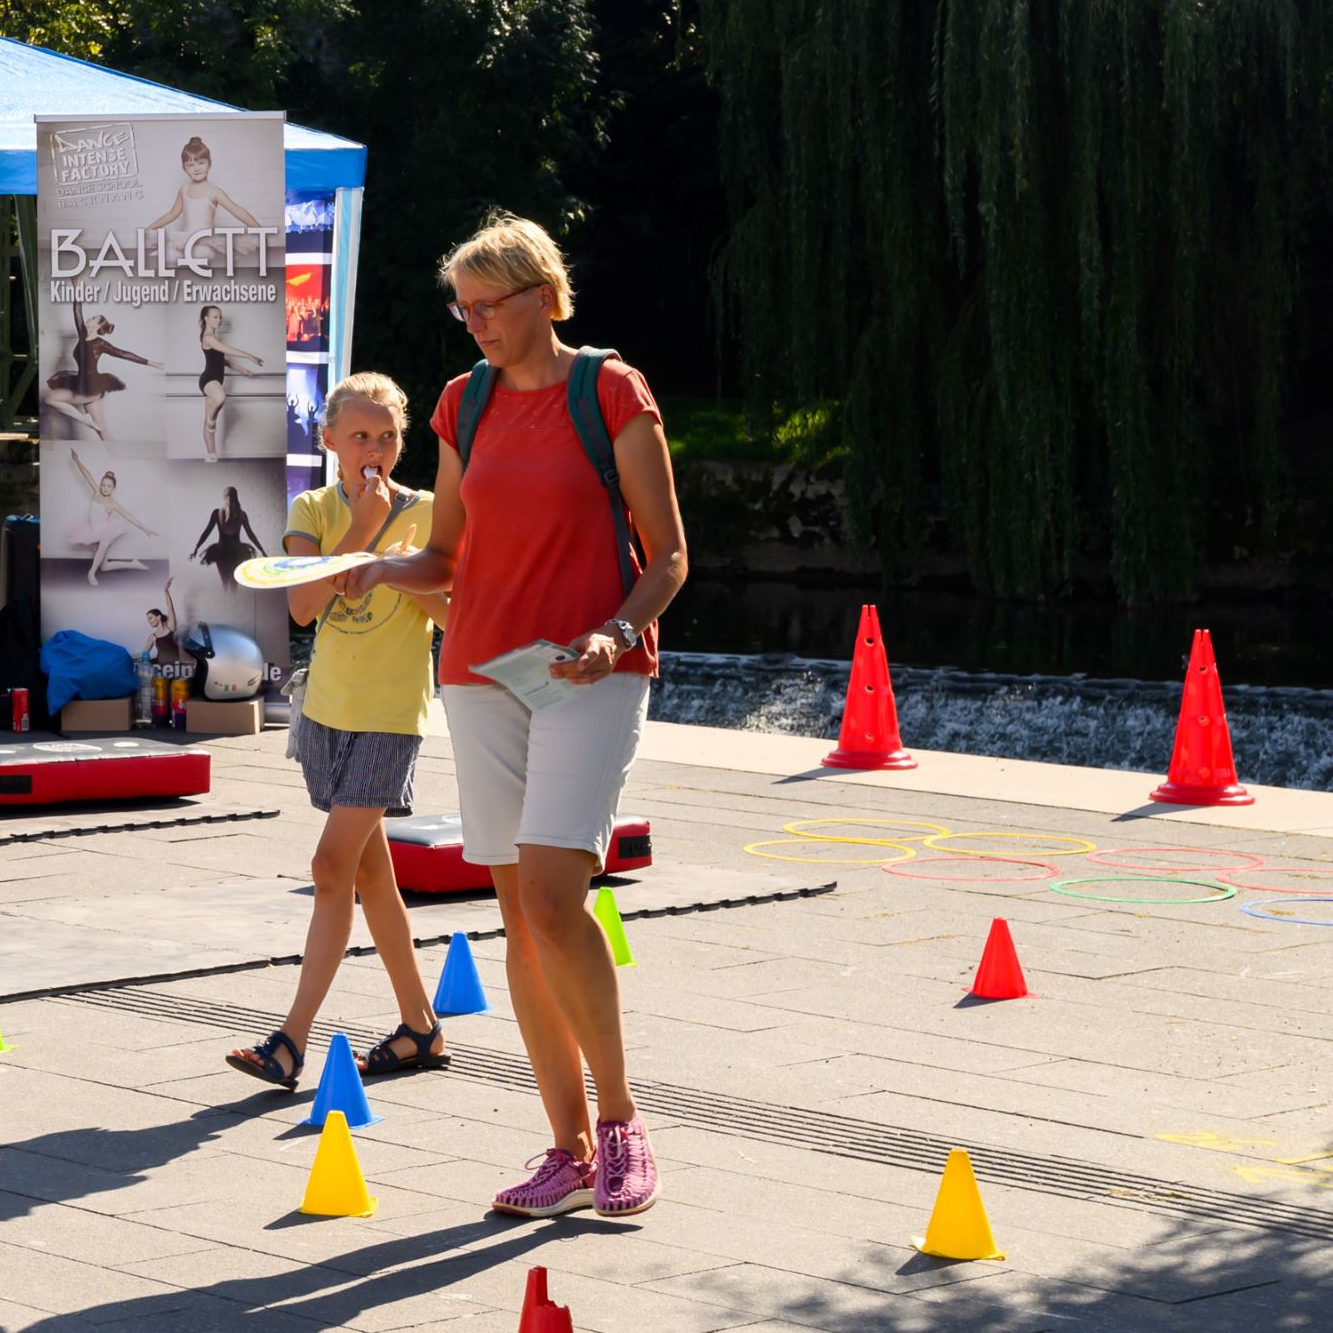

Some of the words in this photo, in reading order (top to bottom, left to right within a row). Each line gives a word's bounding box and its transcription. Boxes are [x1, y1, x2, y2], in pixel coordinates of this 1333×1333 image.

[54, 130, 130, 153] DANCE
[62, 147, 127, 167] INTENSE
[61, 162, 130, 182] FACTORY
[50, 227, 278, 278] BALLETT
[50, 281, 101, 303] Kinder
[113, 281, 169, 307] Jugend
[183, 281, 277, 303] Erwachsene
